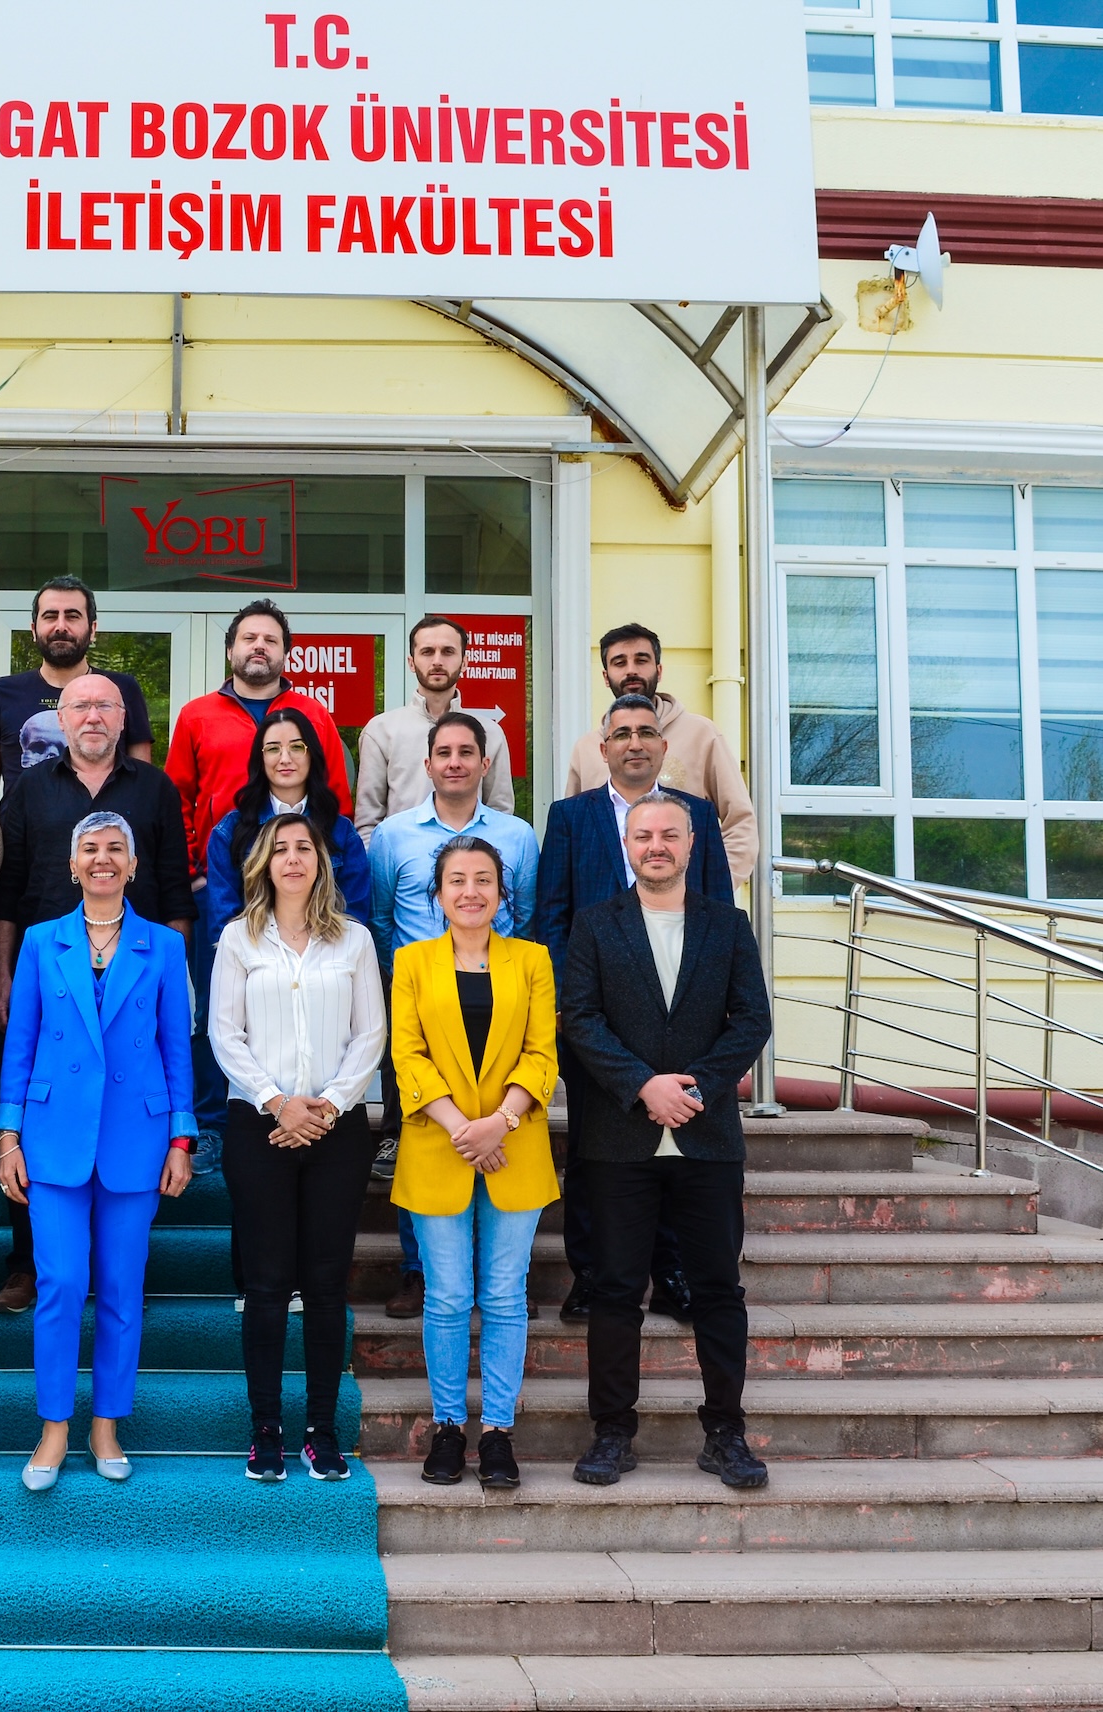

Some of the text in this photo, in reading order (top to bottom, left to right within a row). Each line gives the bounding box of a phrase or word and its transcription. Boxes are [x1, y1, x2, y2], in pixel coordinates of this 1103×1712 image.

[265, 13, 369, 70] T.C.
[130, 101, 330, 161] BOZOK
[350, 93, 750, 171] ÜNİVERSİTESİ
[25, 178, 614, 260] İLETİŞİM FAKÜLTESİ
[130, 498, 267, 556] YOBU
[473, 633, 485, 645] VE
[486, 631, 523, 646] MİSAFİR
[466, 666, 517, 680] TARAFTADIR
